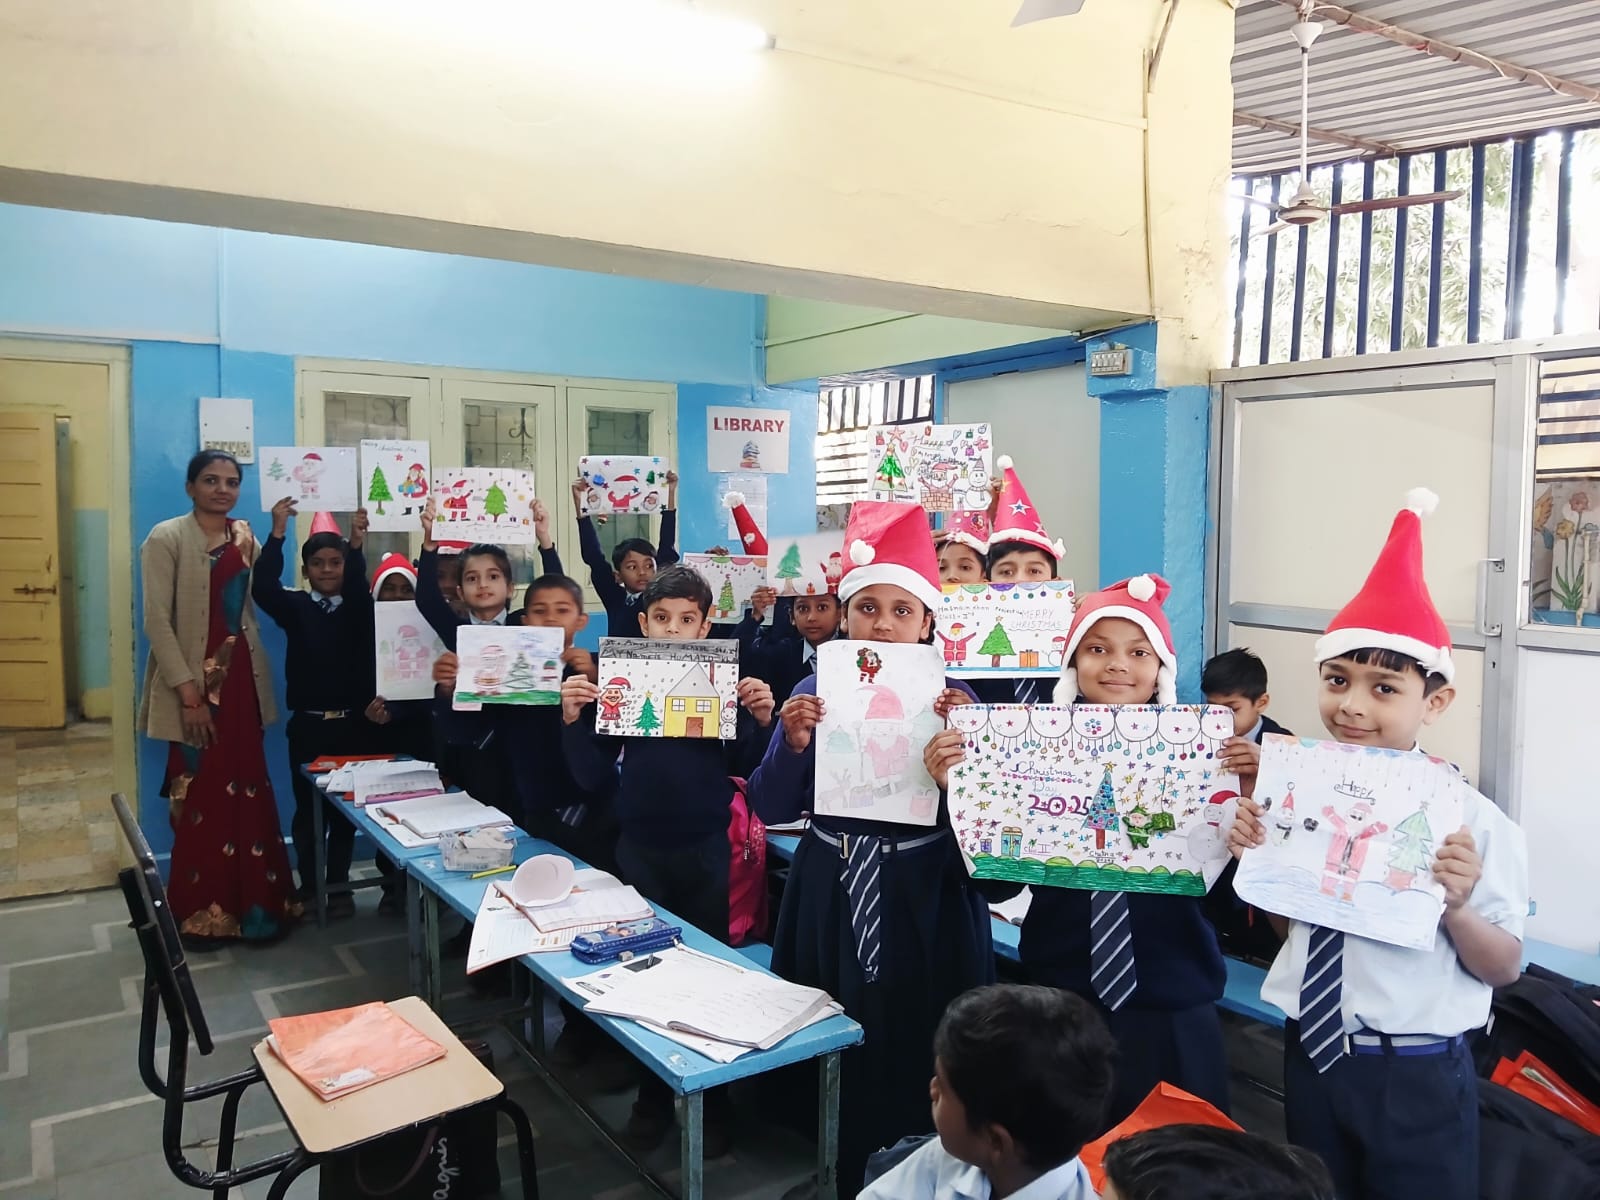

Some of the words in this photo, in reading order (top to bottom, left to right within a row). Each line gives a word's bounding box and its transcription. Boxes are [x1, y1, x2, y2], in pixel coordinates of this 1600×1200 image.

[713, 417, 785, 433] LIBRARY
[1010, 761, 1076, 777] Christmas
[1028, 794, 1093, 816] 2025
